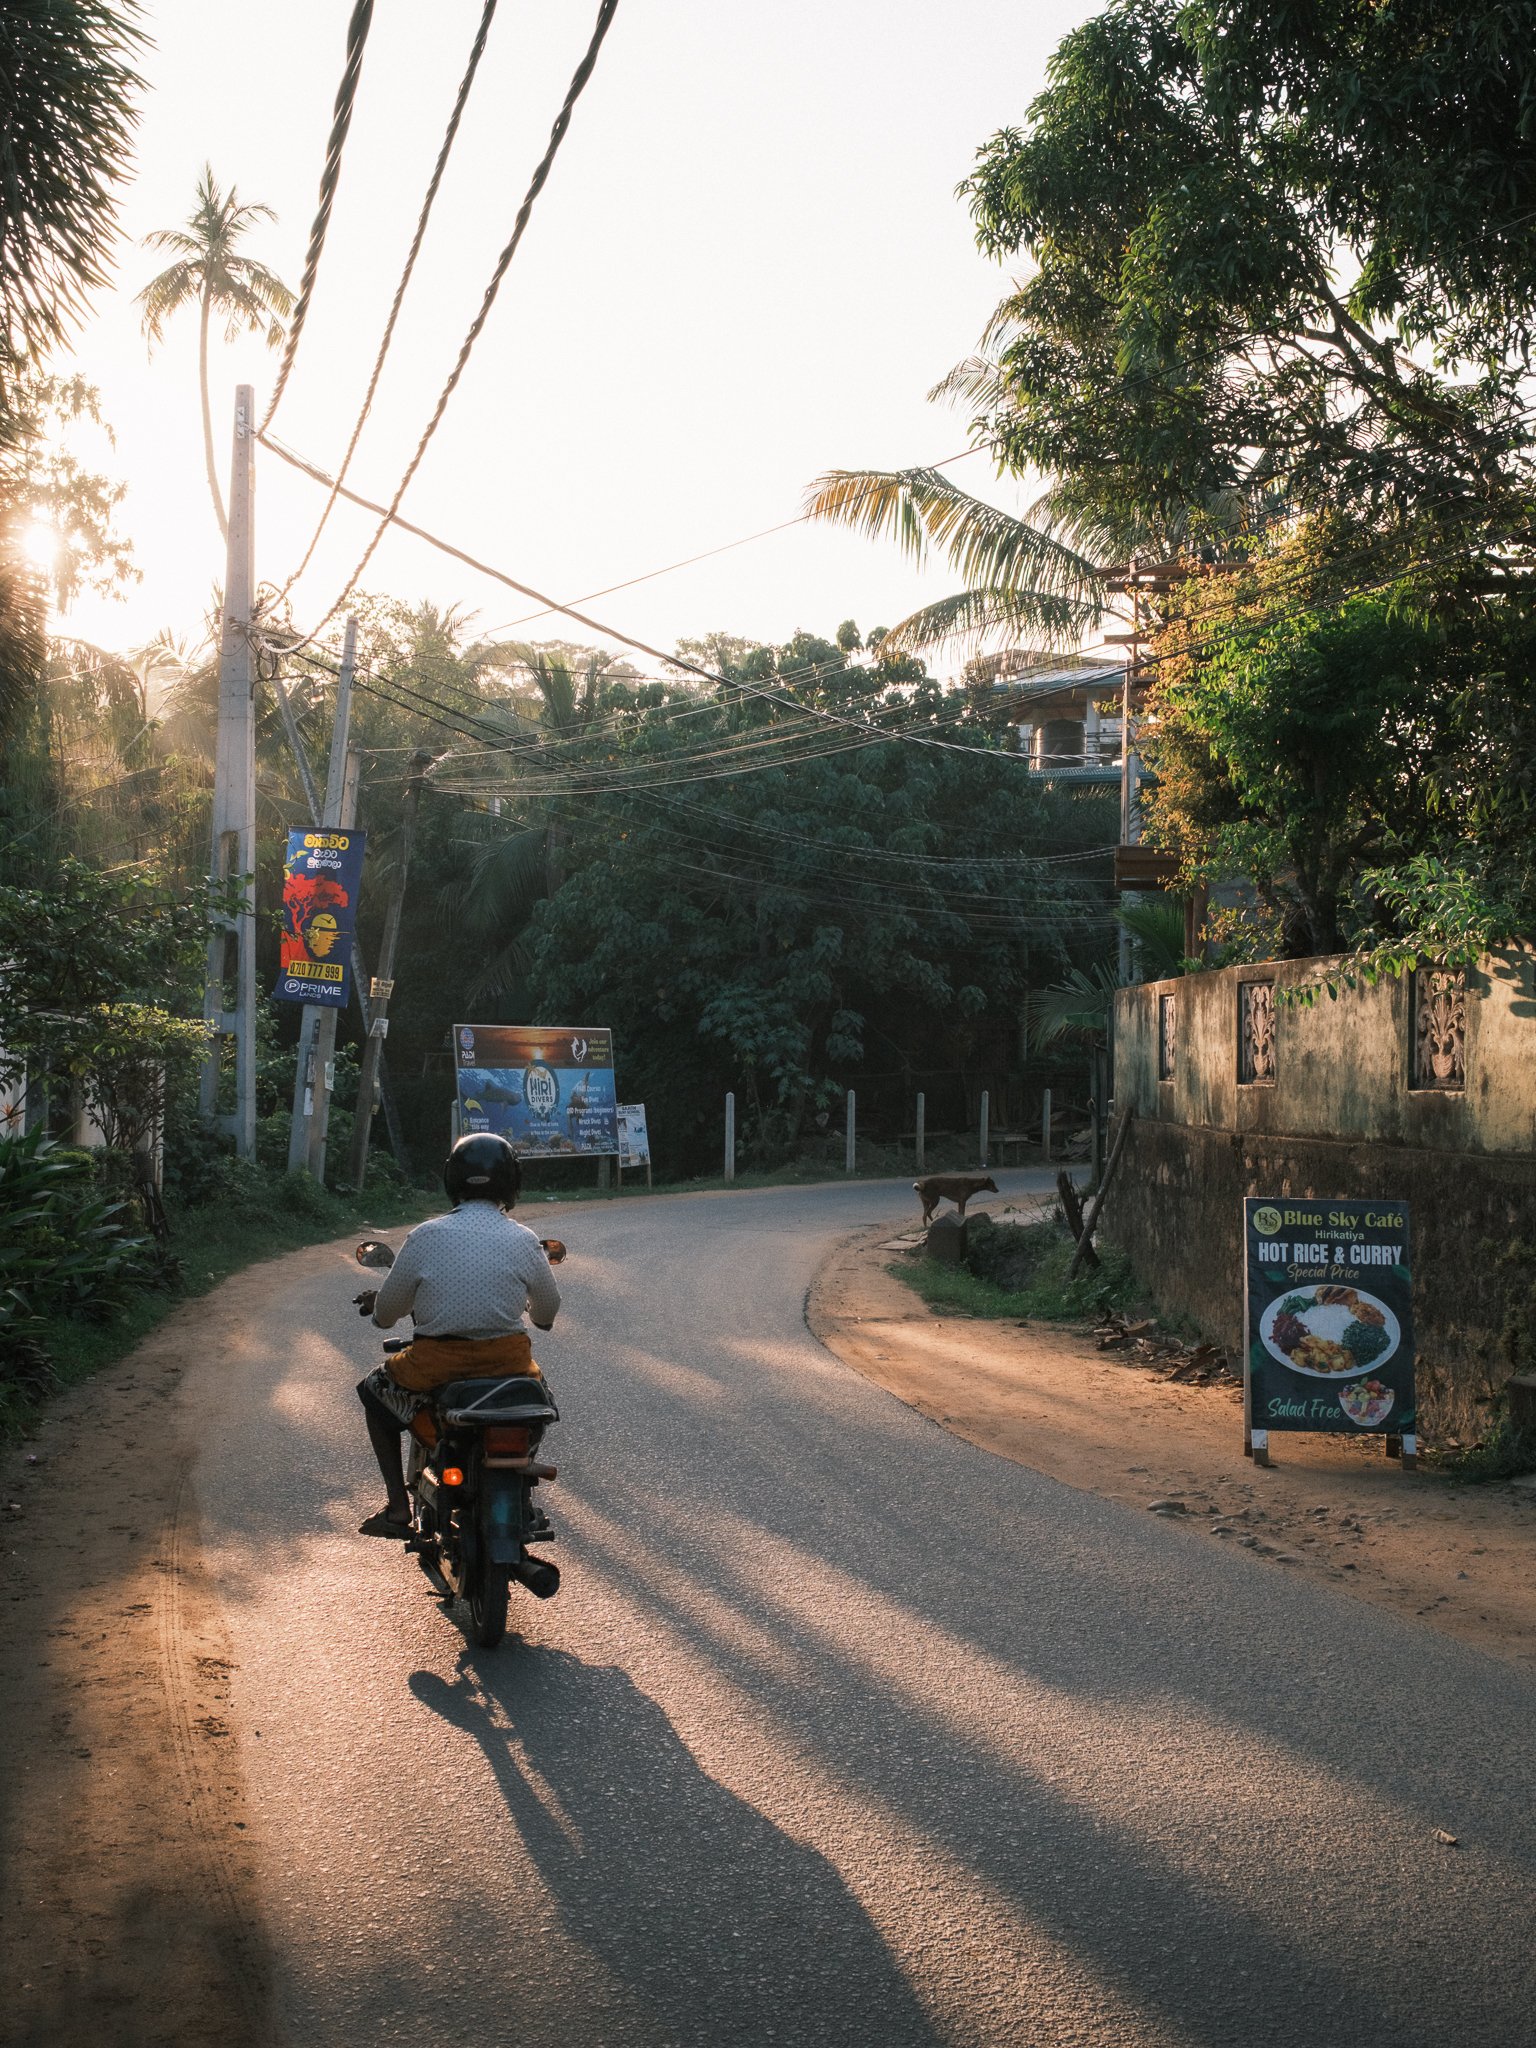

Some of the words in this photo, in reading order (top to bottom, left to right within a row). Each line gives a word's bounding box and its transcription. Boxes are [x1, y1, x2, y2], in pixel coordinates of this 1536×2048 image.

[289, 962, 306, 976] 0710
[307, 964, 323, 977] 777
[324, 965, 340, 979] 999
[300, 982, 342, 996] PRIME
[1284, 1210, 1323, 1226] Blue
[1328, 1211, 1360, 1230] Sky
[1364, 1212, 1404, 1228] Café
[1315, 1230, 1365, 1242] Hirikatiya
[1258, 1242, 1289, 1262] HOT
[1293, 1243, 1329, 1263] RICE
[1333, 1246, 1345, 1264] &
[1350, 1245, 1402, 1265] CURRY
[1286, 1263, 1327, 1281] Special
[1330, 1264, 1360, 1279] Price
[1267, 1397, 1308, 1418] Salad
[1310, 1398, 1341, 1419] Free
